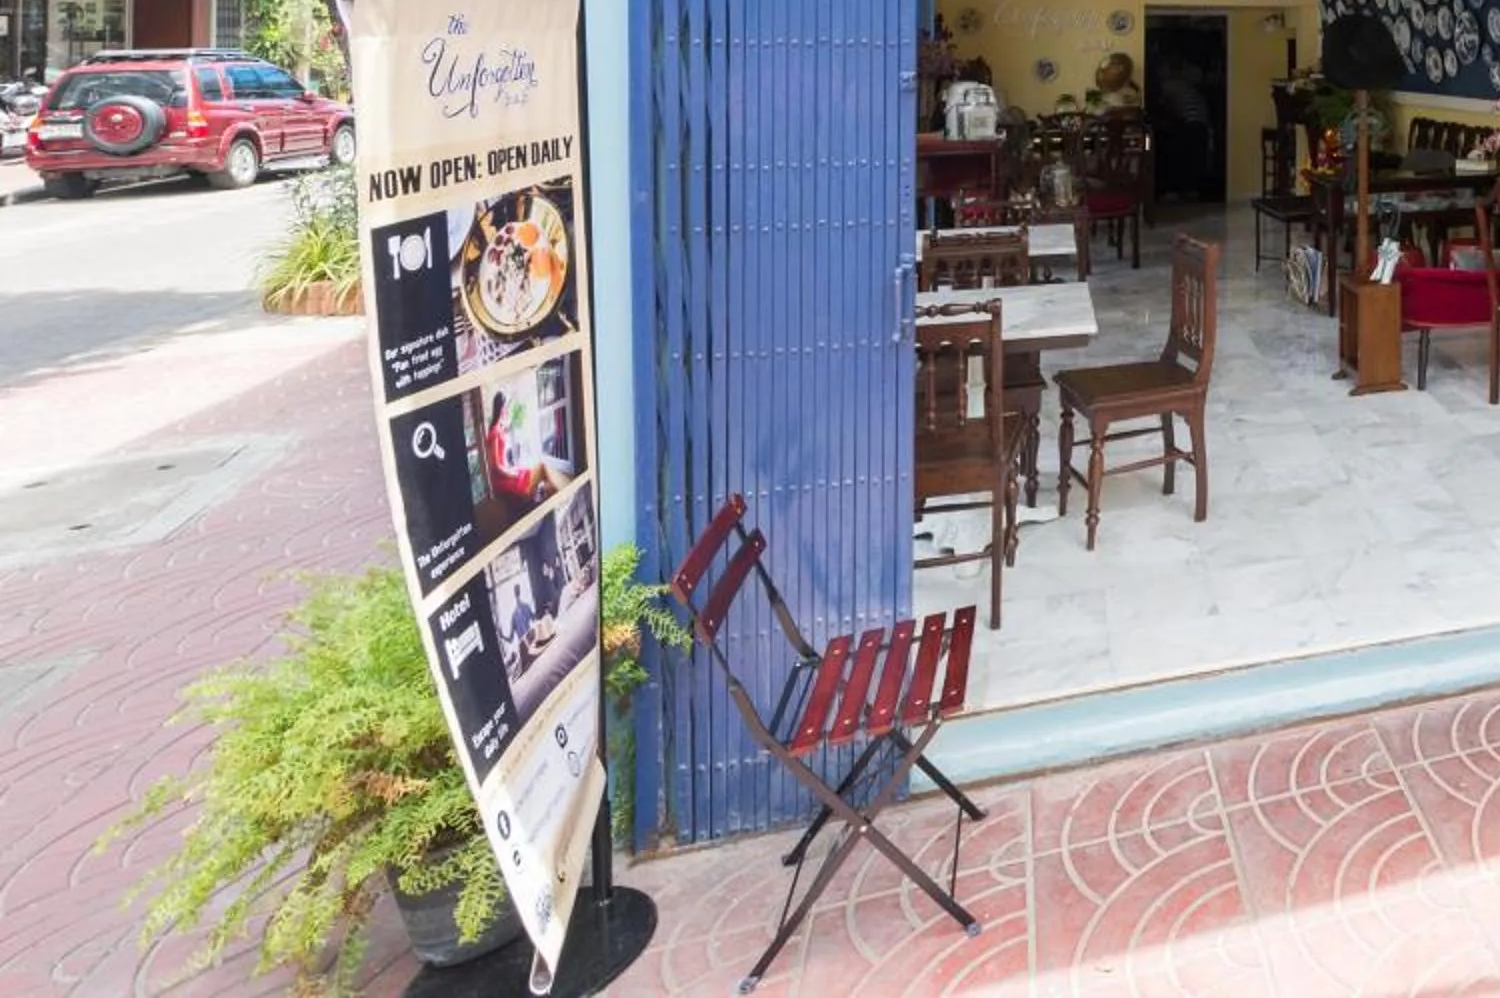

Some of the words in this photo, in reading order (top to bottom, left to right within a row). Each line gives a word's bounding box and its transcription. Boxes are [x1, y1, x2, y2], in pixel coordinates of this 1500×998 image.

[369, 165, 422, 202] NOW
[430, 153, 482, 189] OPEN:
[487, 142, 527, 175] OPEN
[531, 135, 573, 166] DAILY
[417, 553, 431, 570] The
[439, 593, 470, 632] Hotel
